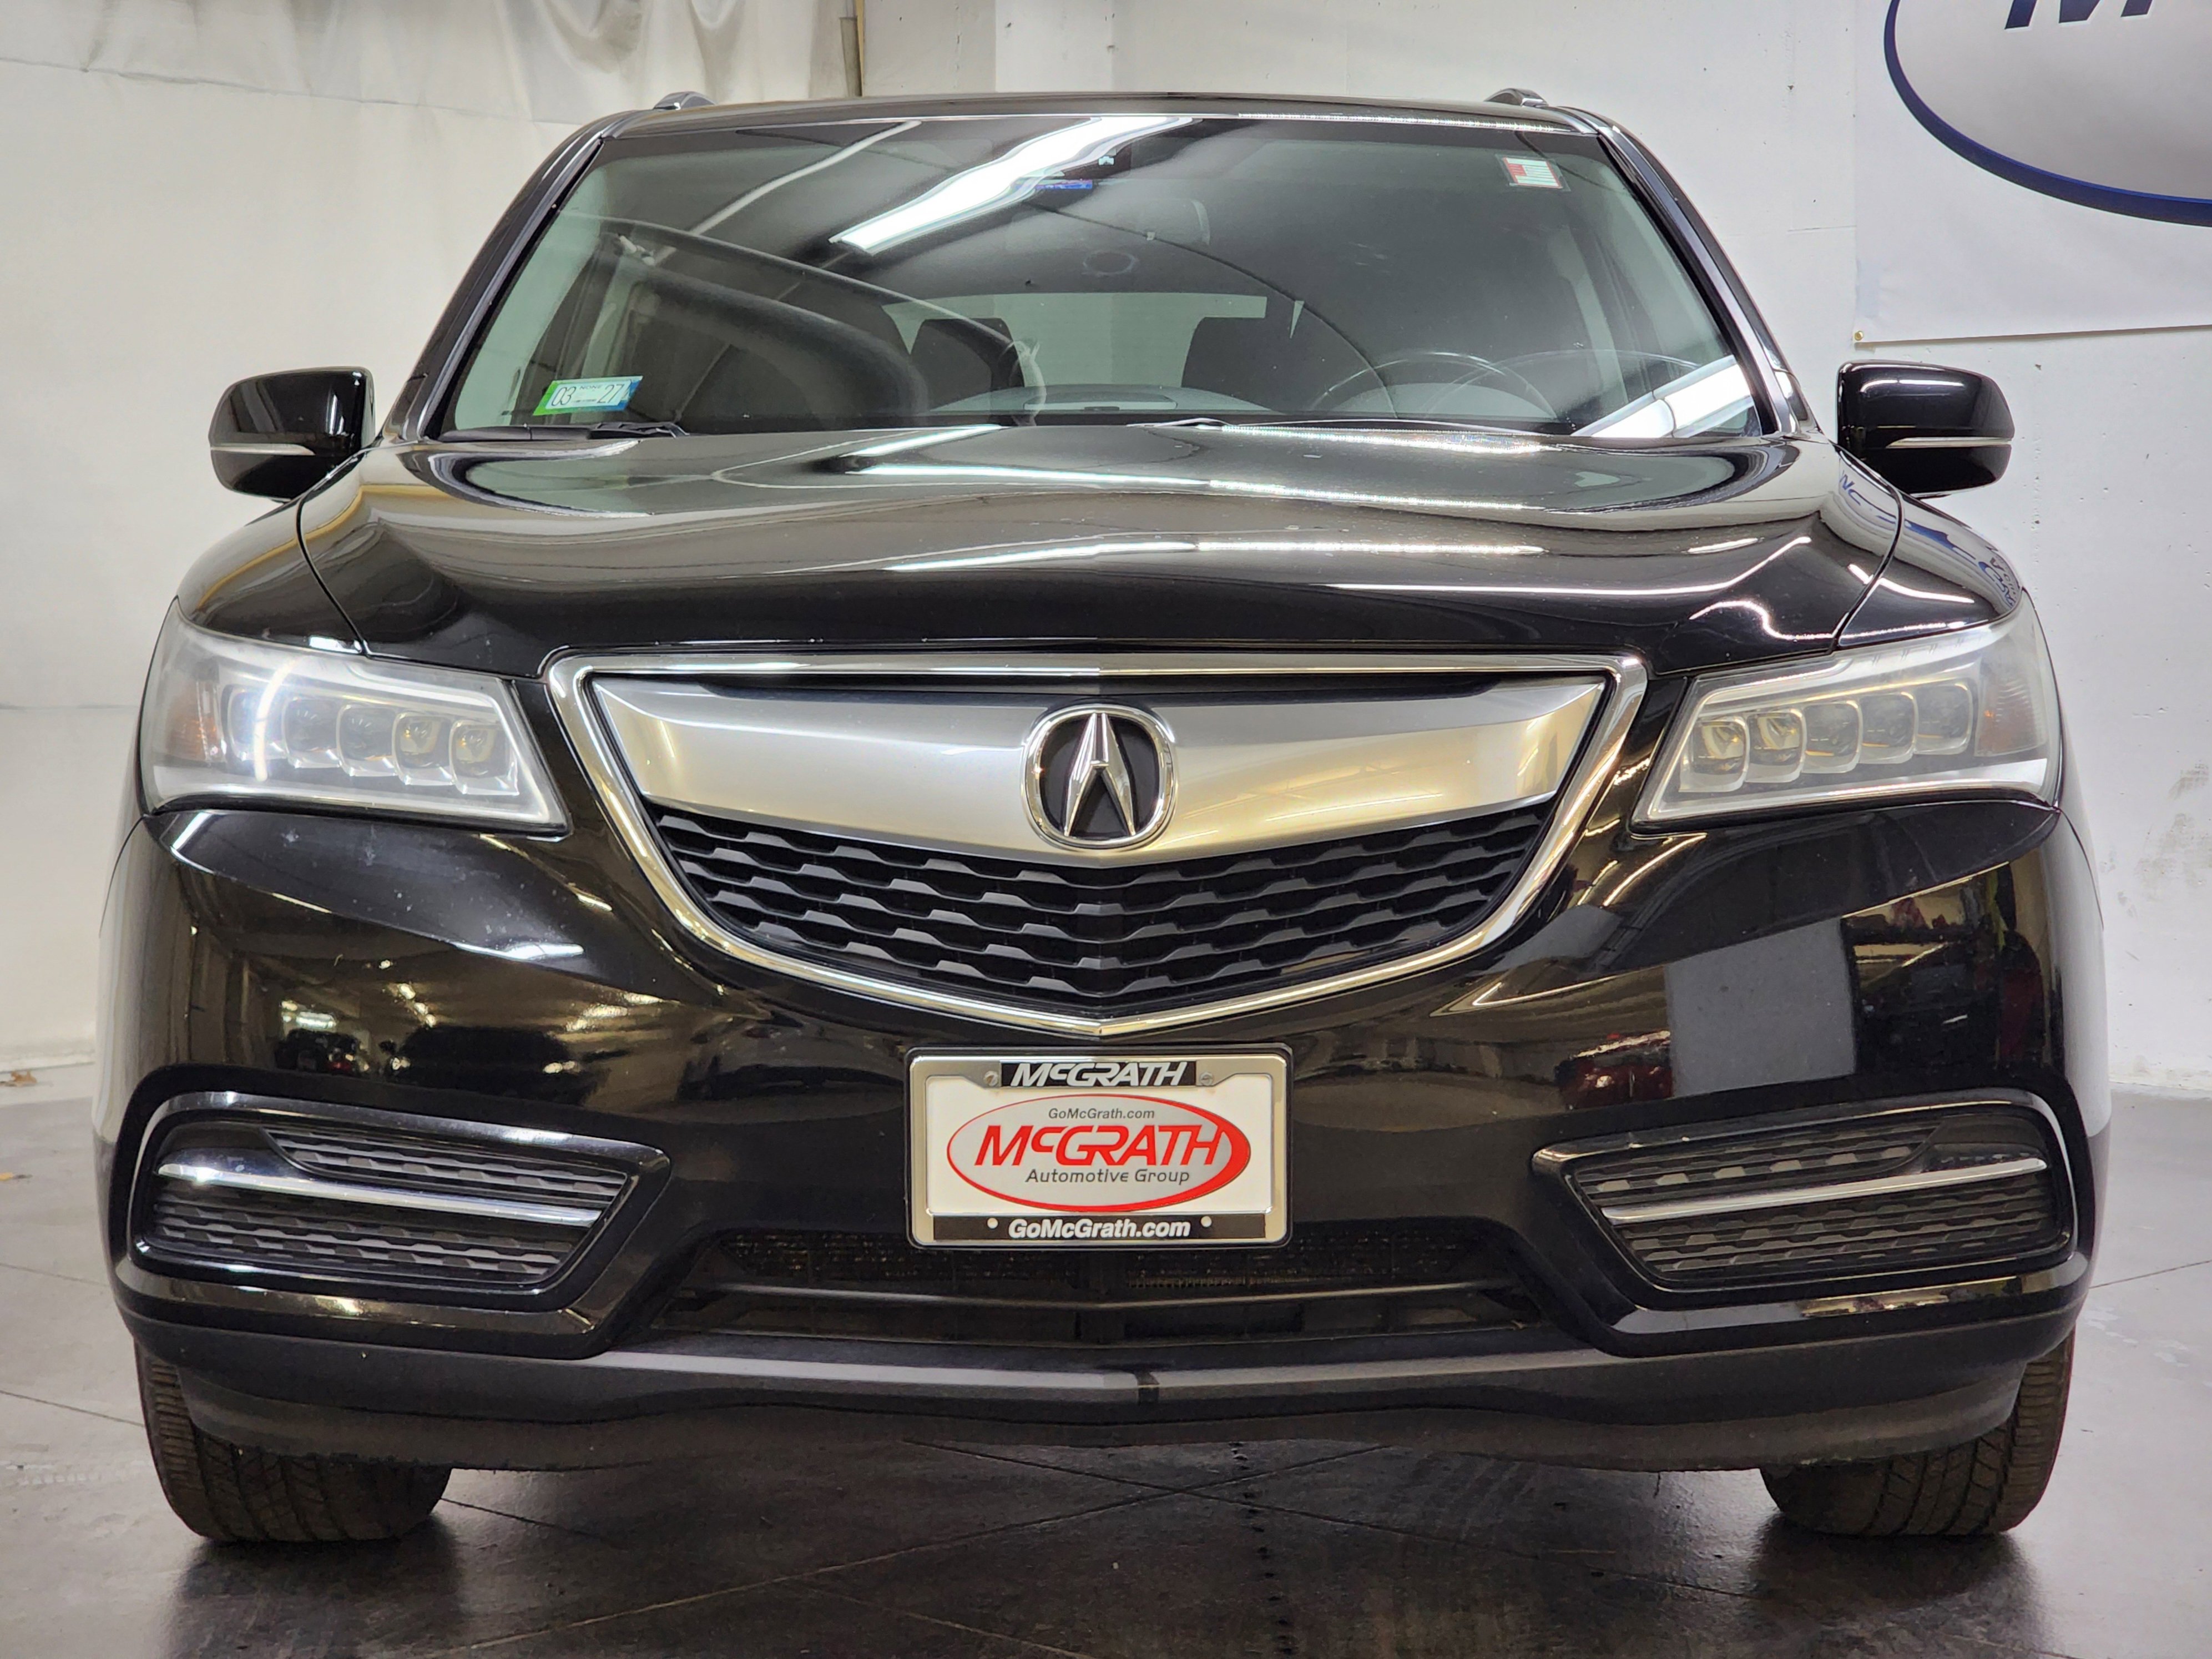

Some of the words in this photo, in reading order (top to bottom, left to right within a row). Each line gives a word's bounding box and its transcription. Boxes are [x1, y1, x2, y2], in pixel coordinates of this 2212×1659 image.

[551, 386, 576, 406] 03
[597, 384, 625, 404] 27
[1048, 1108, 1155, 1120] GoMcGrath.com
[1025, 1168, 1129, 1183] Automotive
[1135, 1168, 1190, 1186] Group
[1008, 1218, 1191, 1239] GoMcGrath.com
